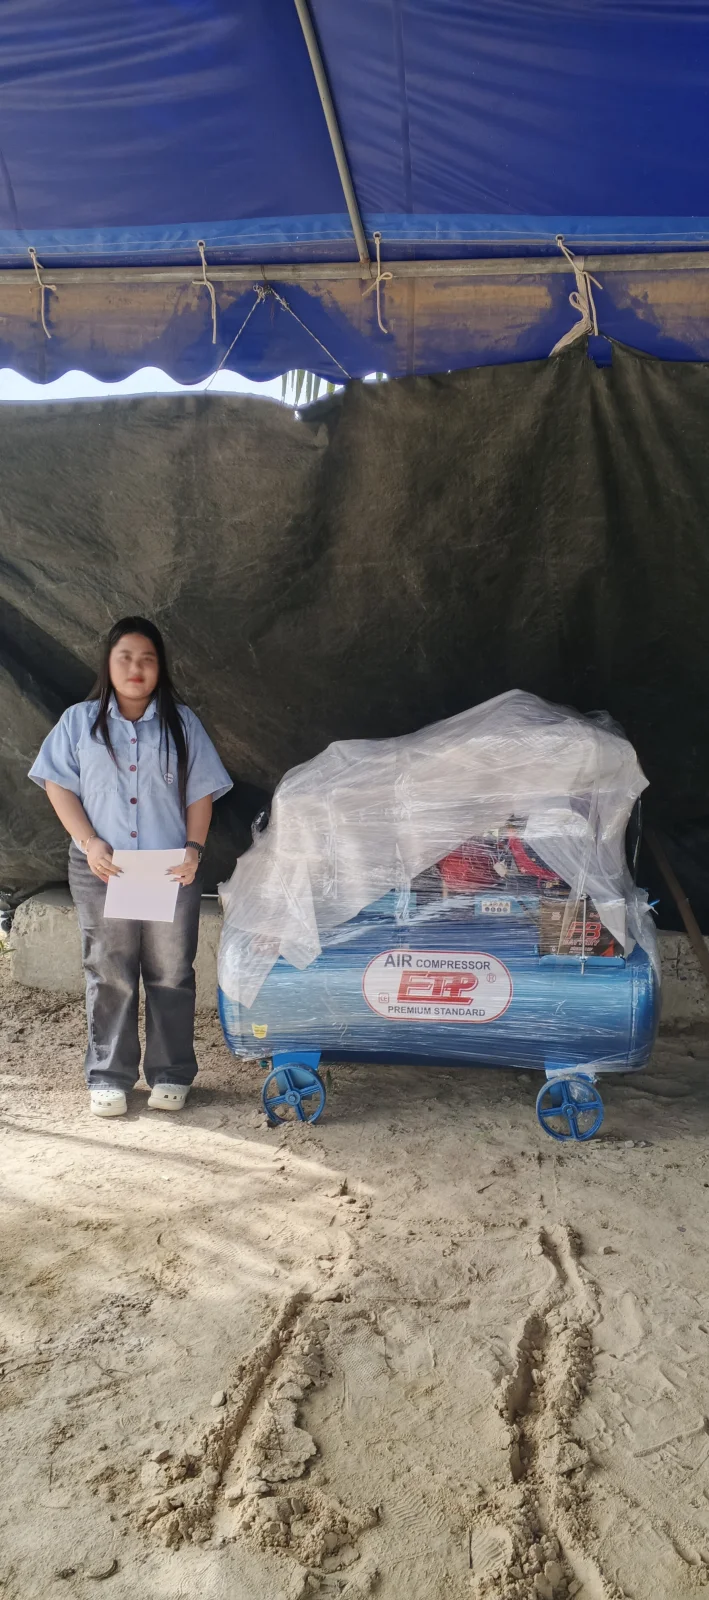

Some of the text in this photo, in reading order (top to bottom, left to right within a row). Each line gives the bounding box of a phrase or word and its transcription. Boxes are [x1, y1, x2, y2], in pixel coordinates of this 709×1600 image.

[565, 921, 602, 940] FB
[384, 954, 491, 970] AIR COMPRESSOR
[388, 1005, 485, 1017] PREMIUM STANDARD
